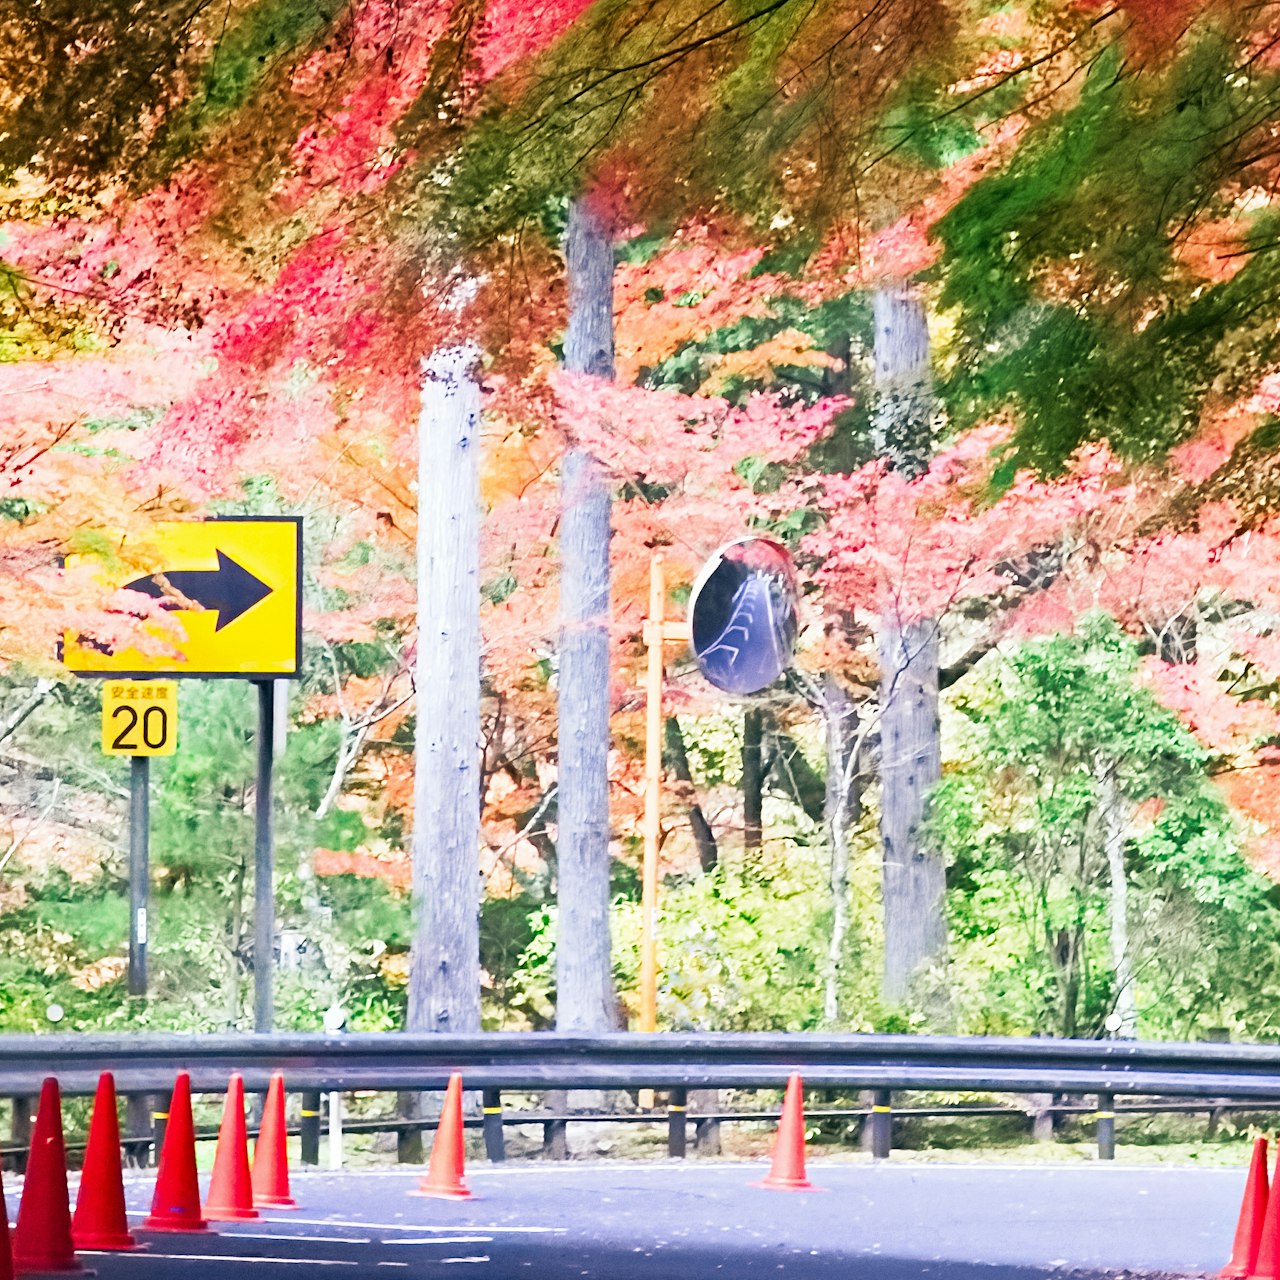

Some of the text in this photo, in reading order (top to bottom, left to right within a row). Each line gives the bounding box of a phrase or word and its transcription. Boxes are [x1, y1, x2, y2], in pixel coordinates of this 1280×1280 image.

[111, 686, 169, 700] 安全速度
[112, 705, 167, 749] 20
